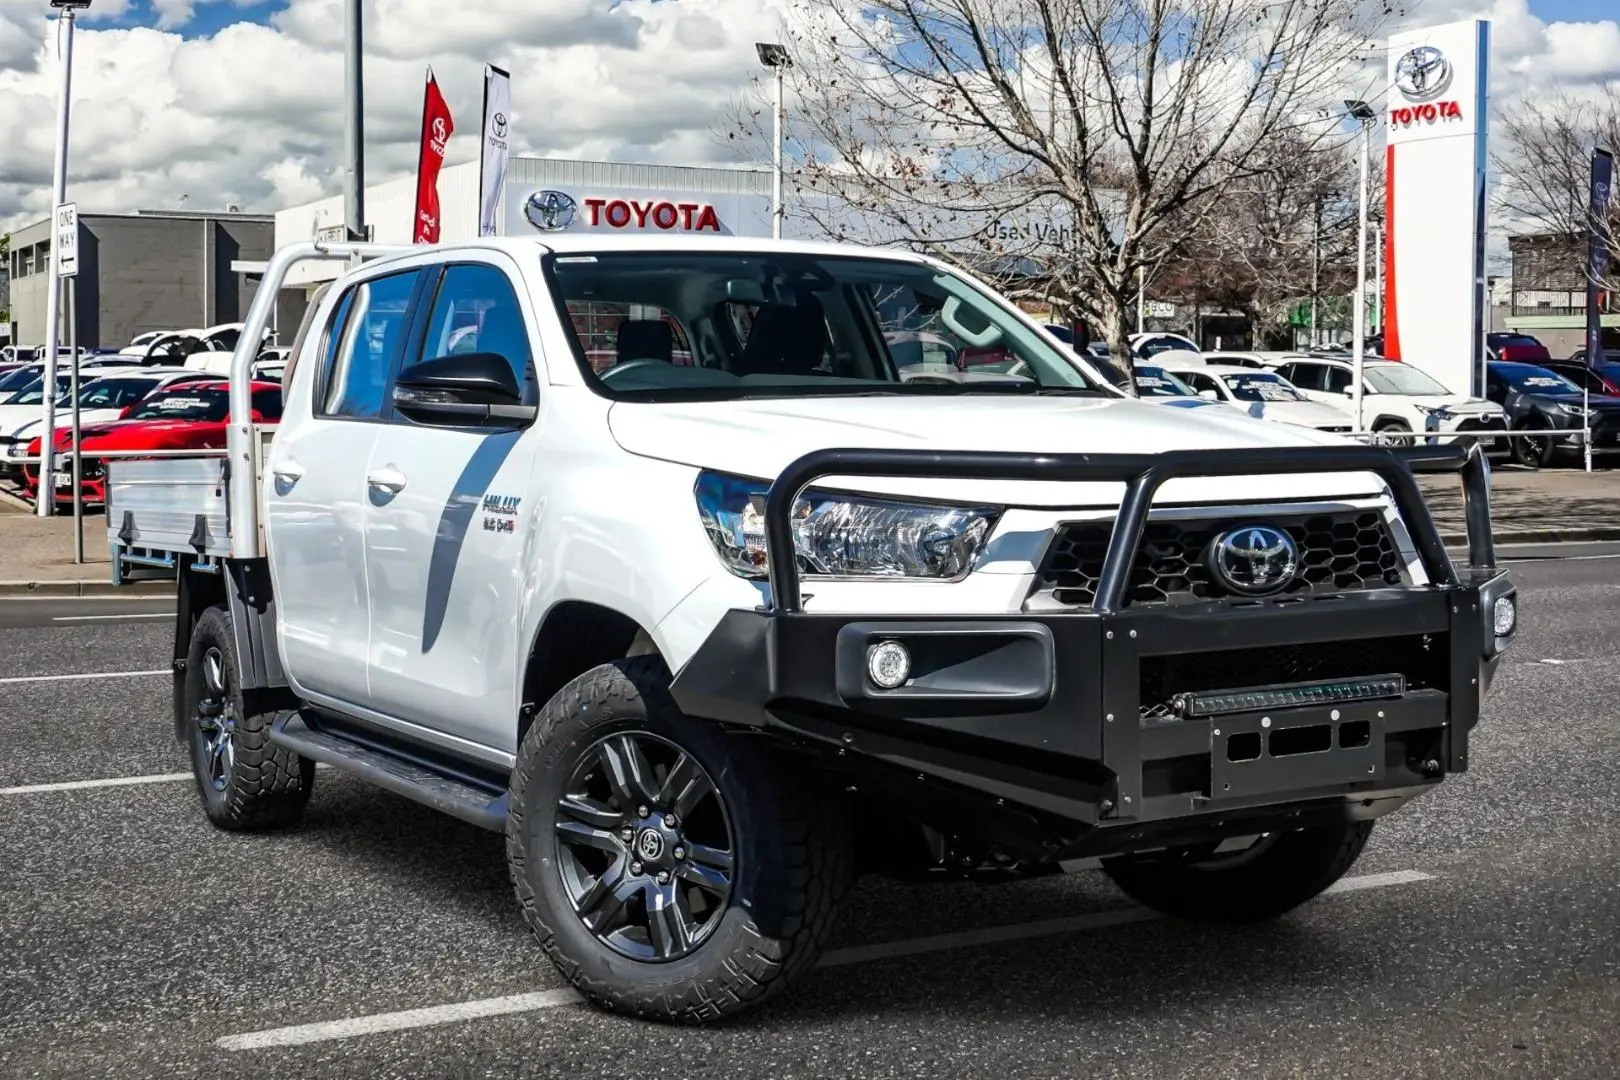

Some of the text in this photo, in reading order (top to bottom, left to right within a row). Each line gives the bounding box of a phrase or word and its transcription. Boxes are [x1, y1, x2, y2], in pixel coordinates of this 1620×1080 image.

[1389, 100, 1462, 124] TOYOTA
[60, 209, 74, 228] ONE
[584, 199, 721, 232] TOYOTA
[59, 231, 76, 249] WAY
[985, 219, 1030, 240] Used
